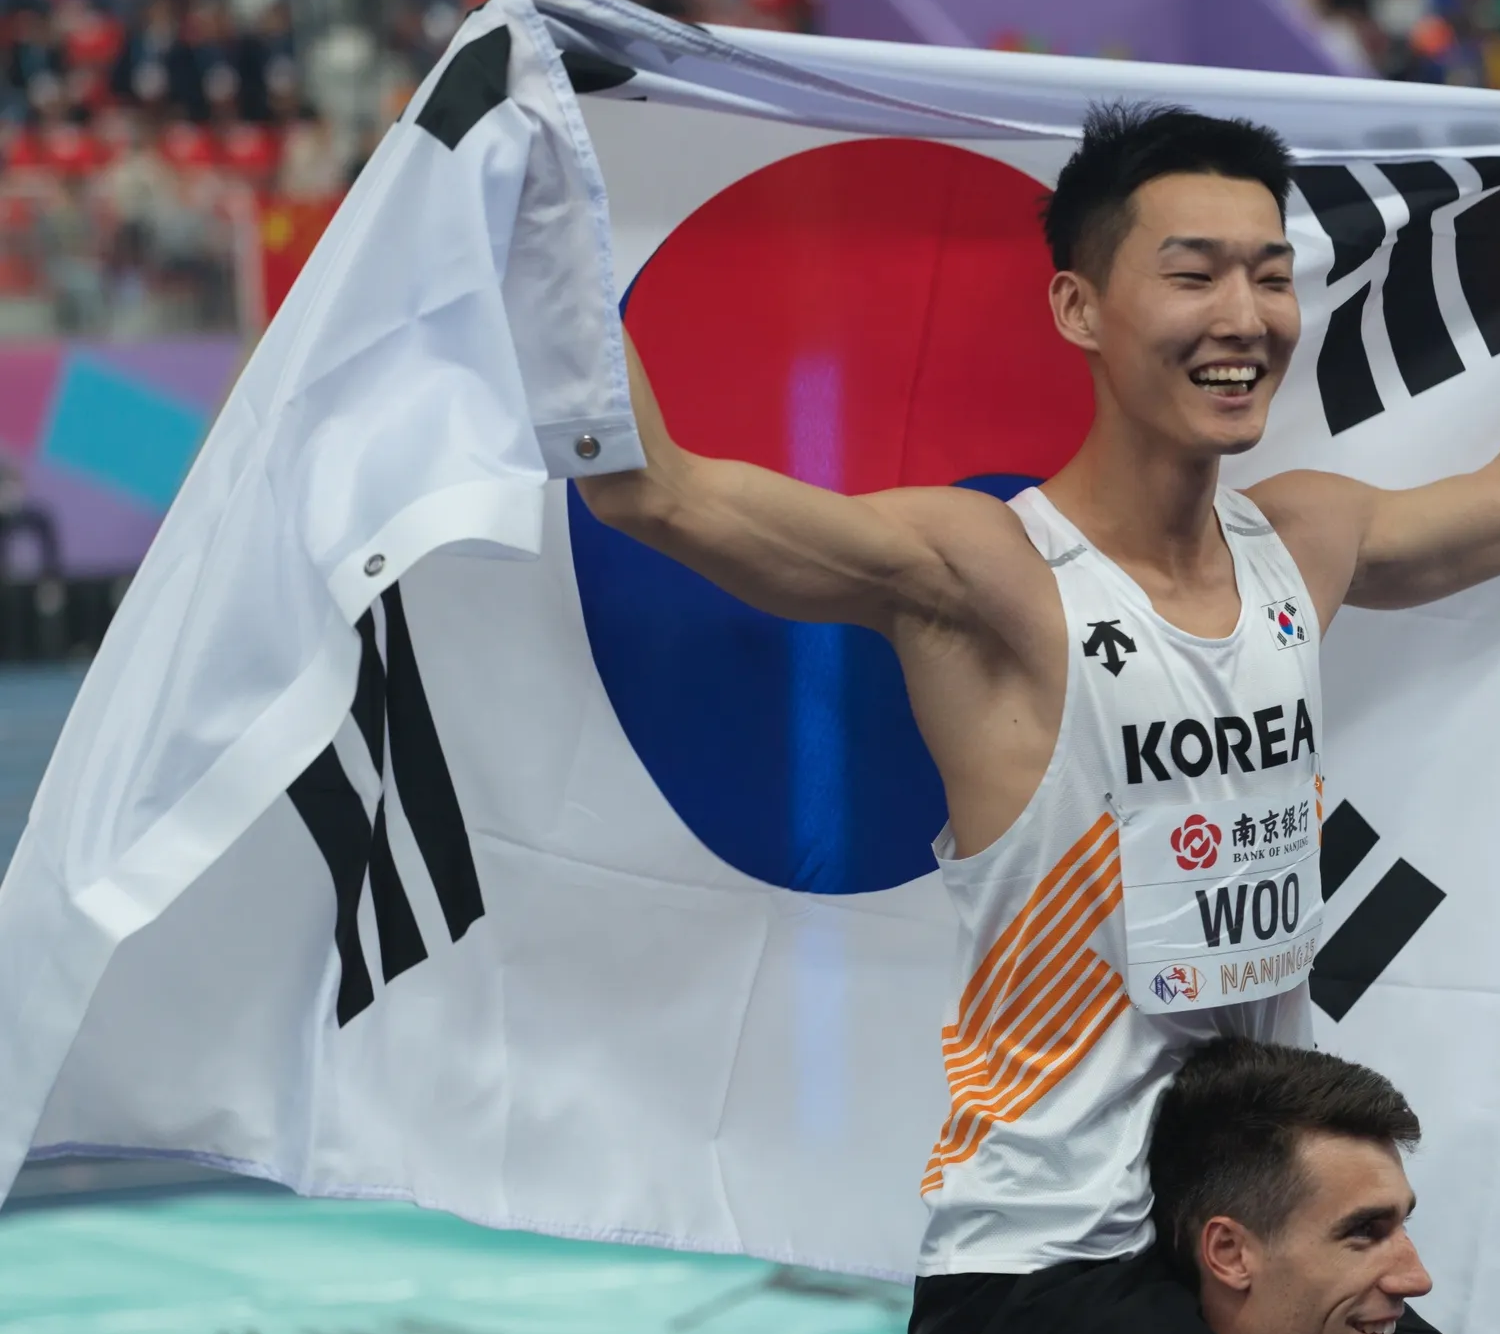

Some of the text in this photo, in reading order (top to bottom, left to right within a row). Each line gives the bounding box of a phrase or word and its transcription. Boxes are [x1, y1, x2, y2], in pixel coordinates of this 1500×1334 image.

[1121, 698, 1315, 784] KOREA
[1231, 799, 1309, 848] 南京银行
[1233, 835, 1309, 863] BANK OF NANJING
[1195, 872, 1299, 948] WOO
